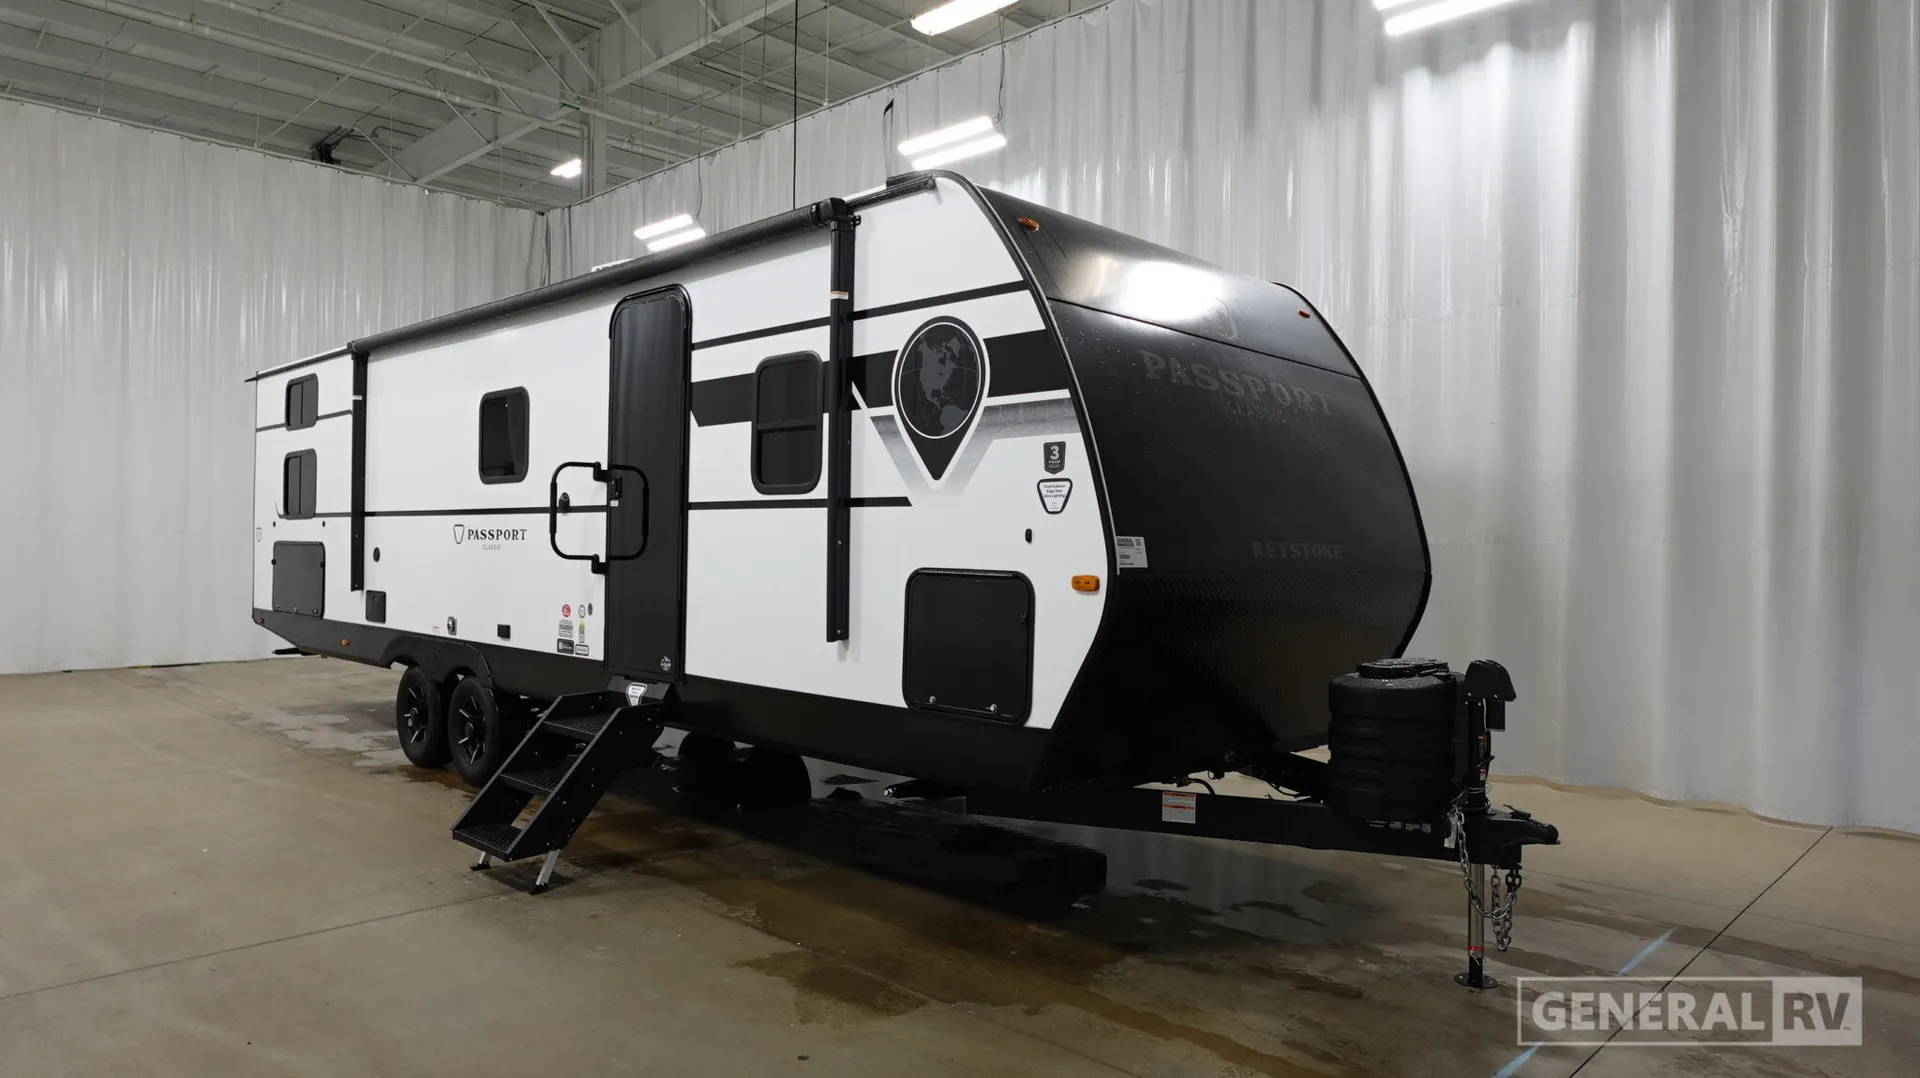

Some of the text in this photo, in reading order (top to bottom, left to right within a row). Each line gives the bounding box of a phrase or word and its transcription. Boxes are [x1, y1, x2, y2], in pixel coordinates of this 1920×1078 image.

[1138, 350, 1332, 415] PASSPORT
[1050, 445, 1060, 460] 3
[467, 529, 527, 541] PASSPORT
[1252, 541, 1345, 559] KEYSTONE
